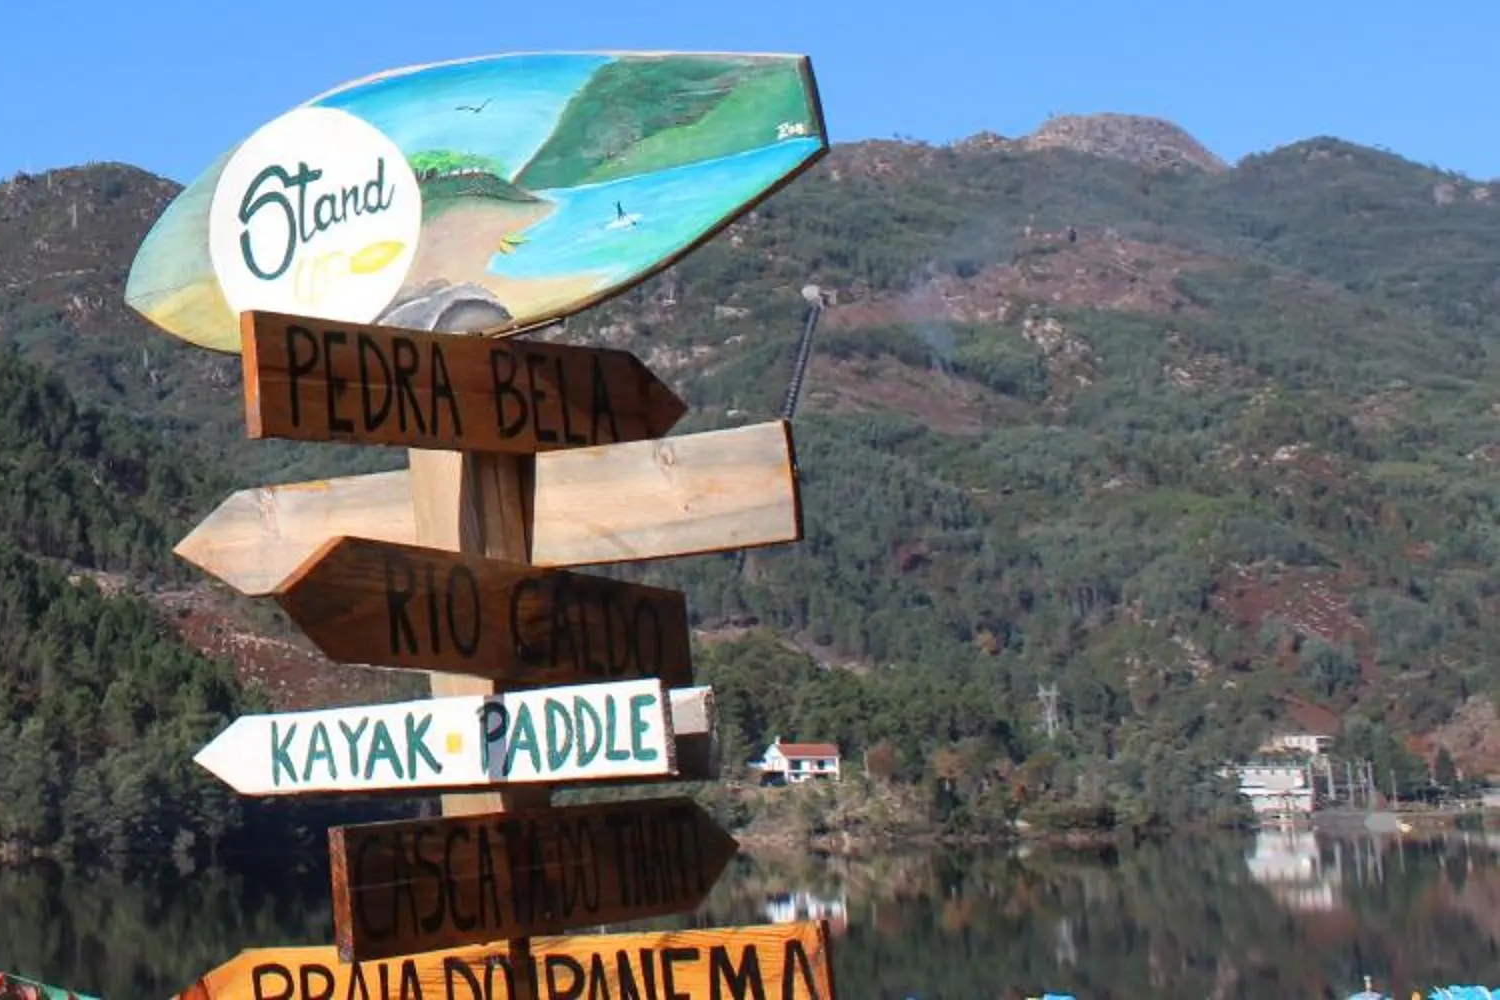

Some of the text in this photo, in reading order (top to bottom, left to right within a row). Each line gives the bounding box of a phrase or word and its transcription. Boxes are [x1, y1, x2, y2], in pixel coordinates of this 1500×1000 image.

[238, 157, 396, 281] Stand
[286, 324, 619, 444] PEDRA BELA
[386, 557, 663, 677] RIO CALDO
[272, 694, 658, 786] KAYAK PADDLE
[355, 819, 548, 937] CASCATA
[555, 815, 601, 918] DO
